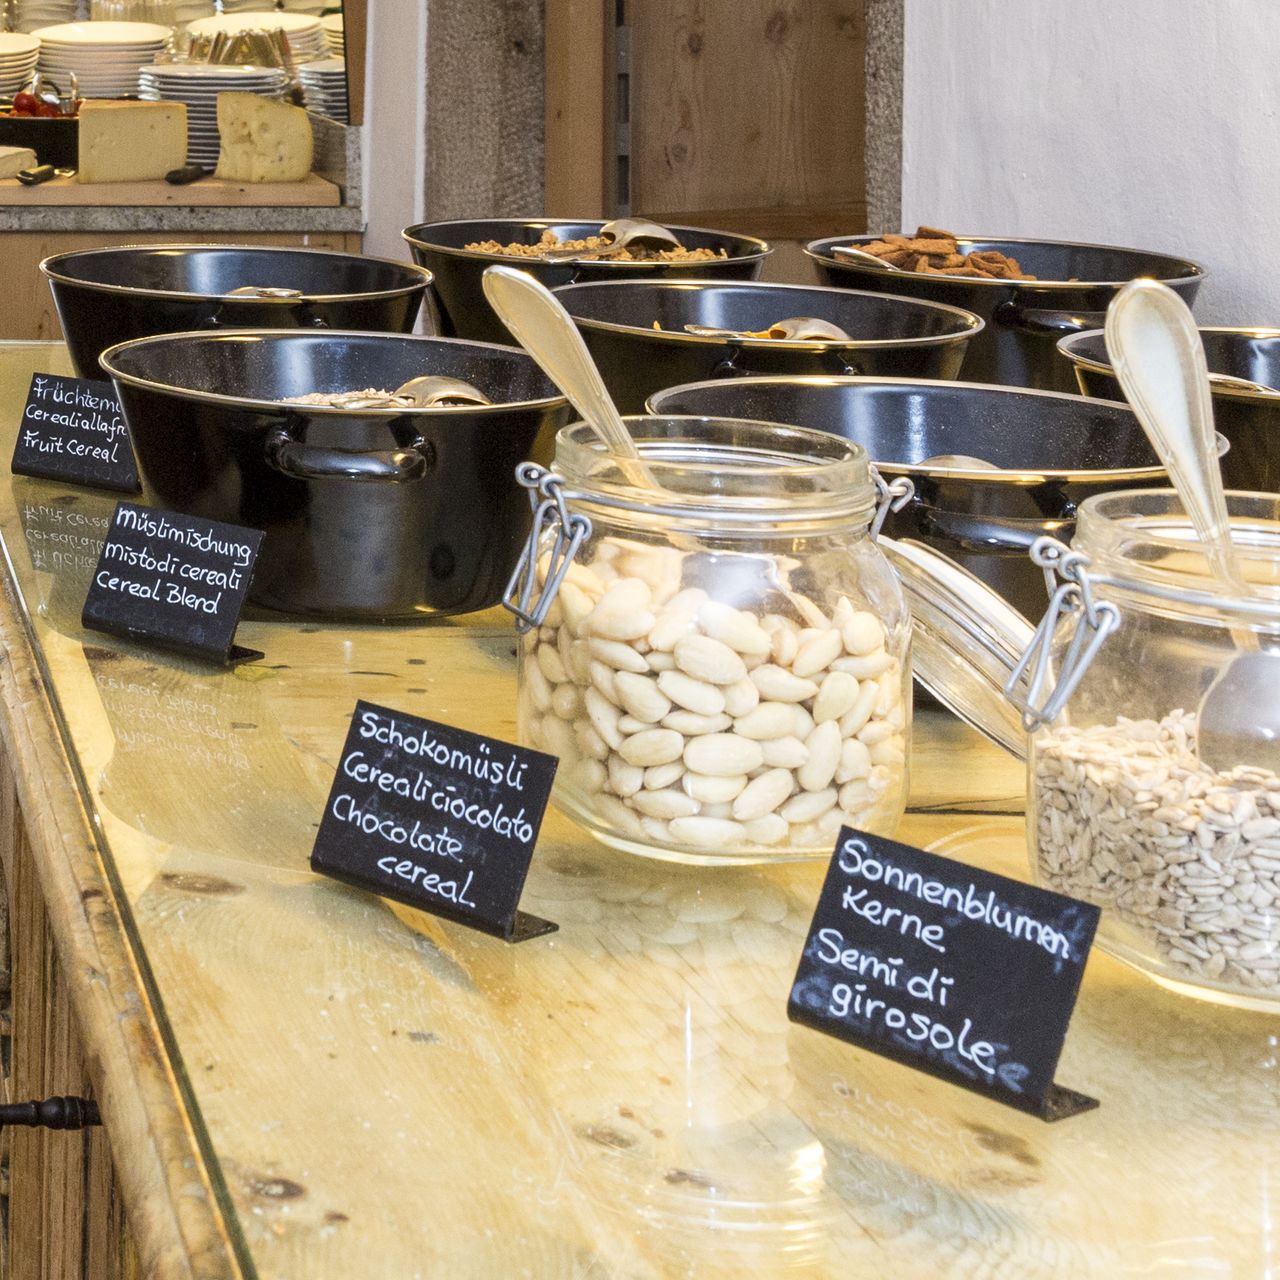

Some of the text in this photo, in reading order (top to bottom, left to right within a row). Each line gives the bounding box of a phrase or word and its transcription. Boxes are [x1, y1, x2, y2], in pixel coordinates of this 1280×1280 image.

[23, 430, 118, 463] Fruit Cereal
[167, 583, 222, 614] Blend
[359, 711, 528, 791] Schokomüsli
[332, 794, 464, 862] Chocolate
[838, 838, 1070, 959] Sonnenblumen
[842, 885, 946, 952] Kerne
[817, 928, 955, 1006] Semi di
[829, 983, 996, 1074] girosole
